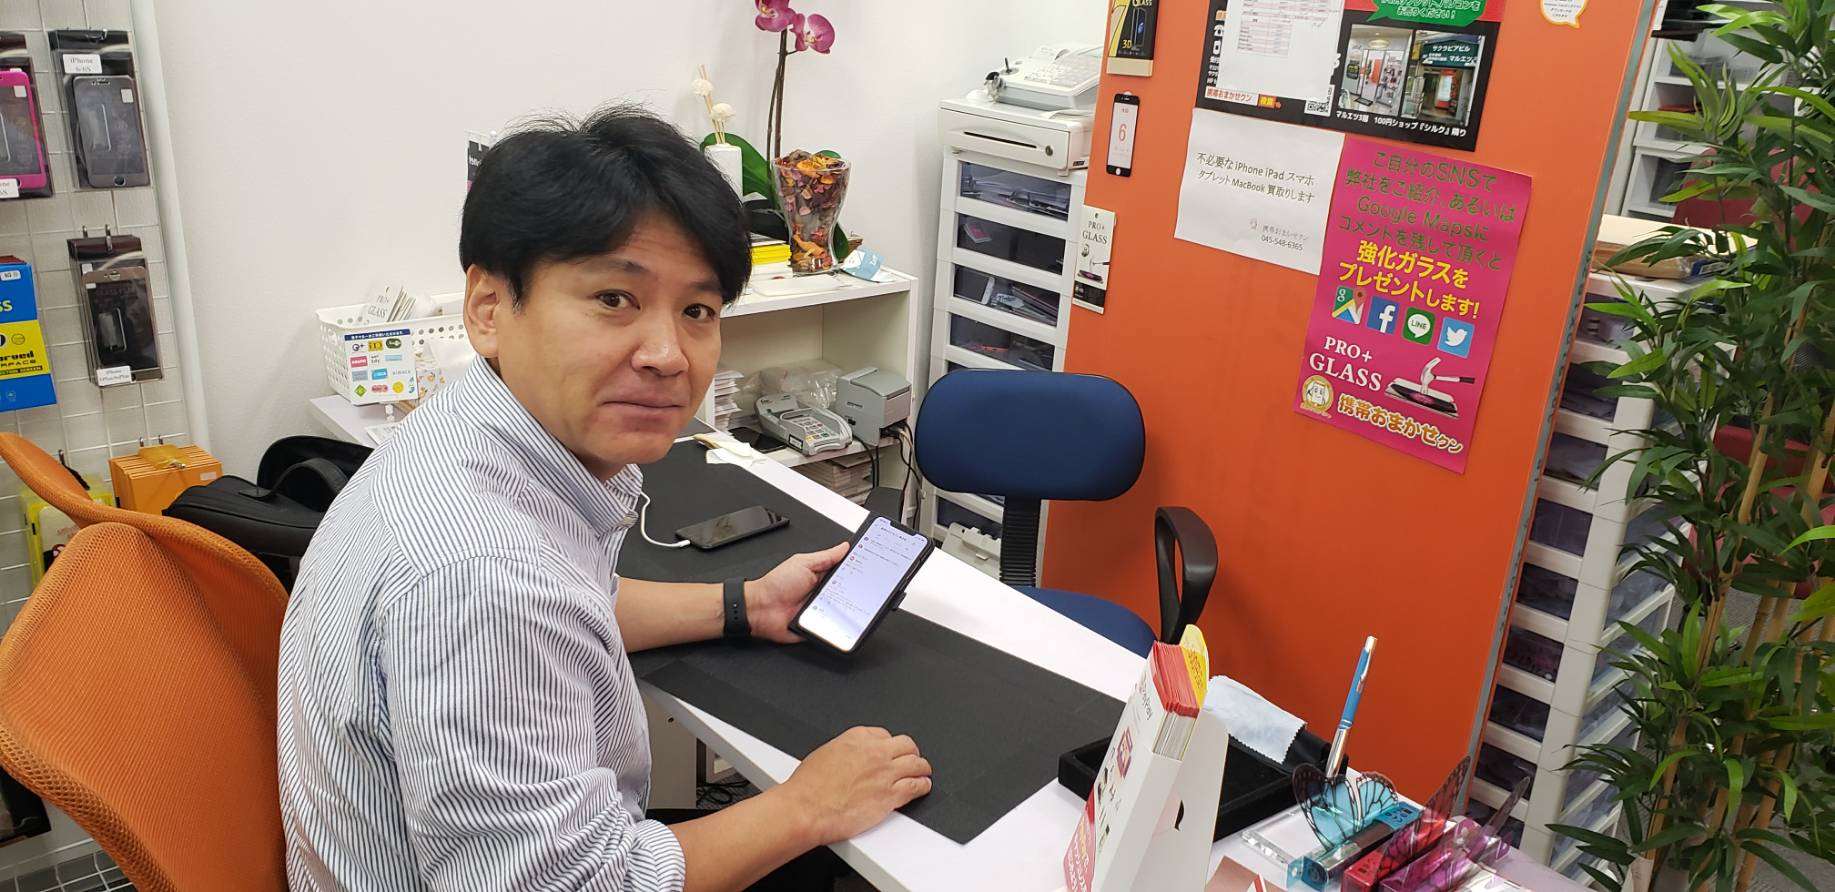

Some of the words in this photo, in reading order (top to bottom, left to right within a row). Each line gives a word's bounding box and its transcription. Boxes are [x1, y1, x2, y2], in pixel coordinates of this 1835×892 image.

[1119, 123, 1127, 142] 6
[1197, 152, 1233, 170] 不必要な
[1235, 161, 1263, 176] iPhone
[1265, 168, 1284, 181] iPad
[1286, 171, 1315, 187] スマホ
[1198, 169, 1231, 185] タブレット
[1232, 178, 1266, 193] MacBook
[1267, 184, 1316, 204] 買取りします
[1358, 196, 1417, 225] Google
[1082, 230, 1108, 244] GLASS
[1357, 240, 1468, 289] 強化ガラスを
[1410, 319, 1428, 330] LINE
[1324, 336, 1373, 363] PRO+
[1309, 353, 1383, 391] GLASS
[1337, 392, 1464, 454] 携帯おまかせクン
